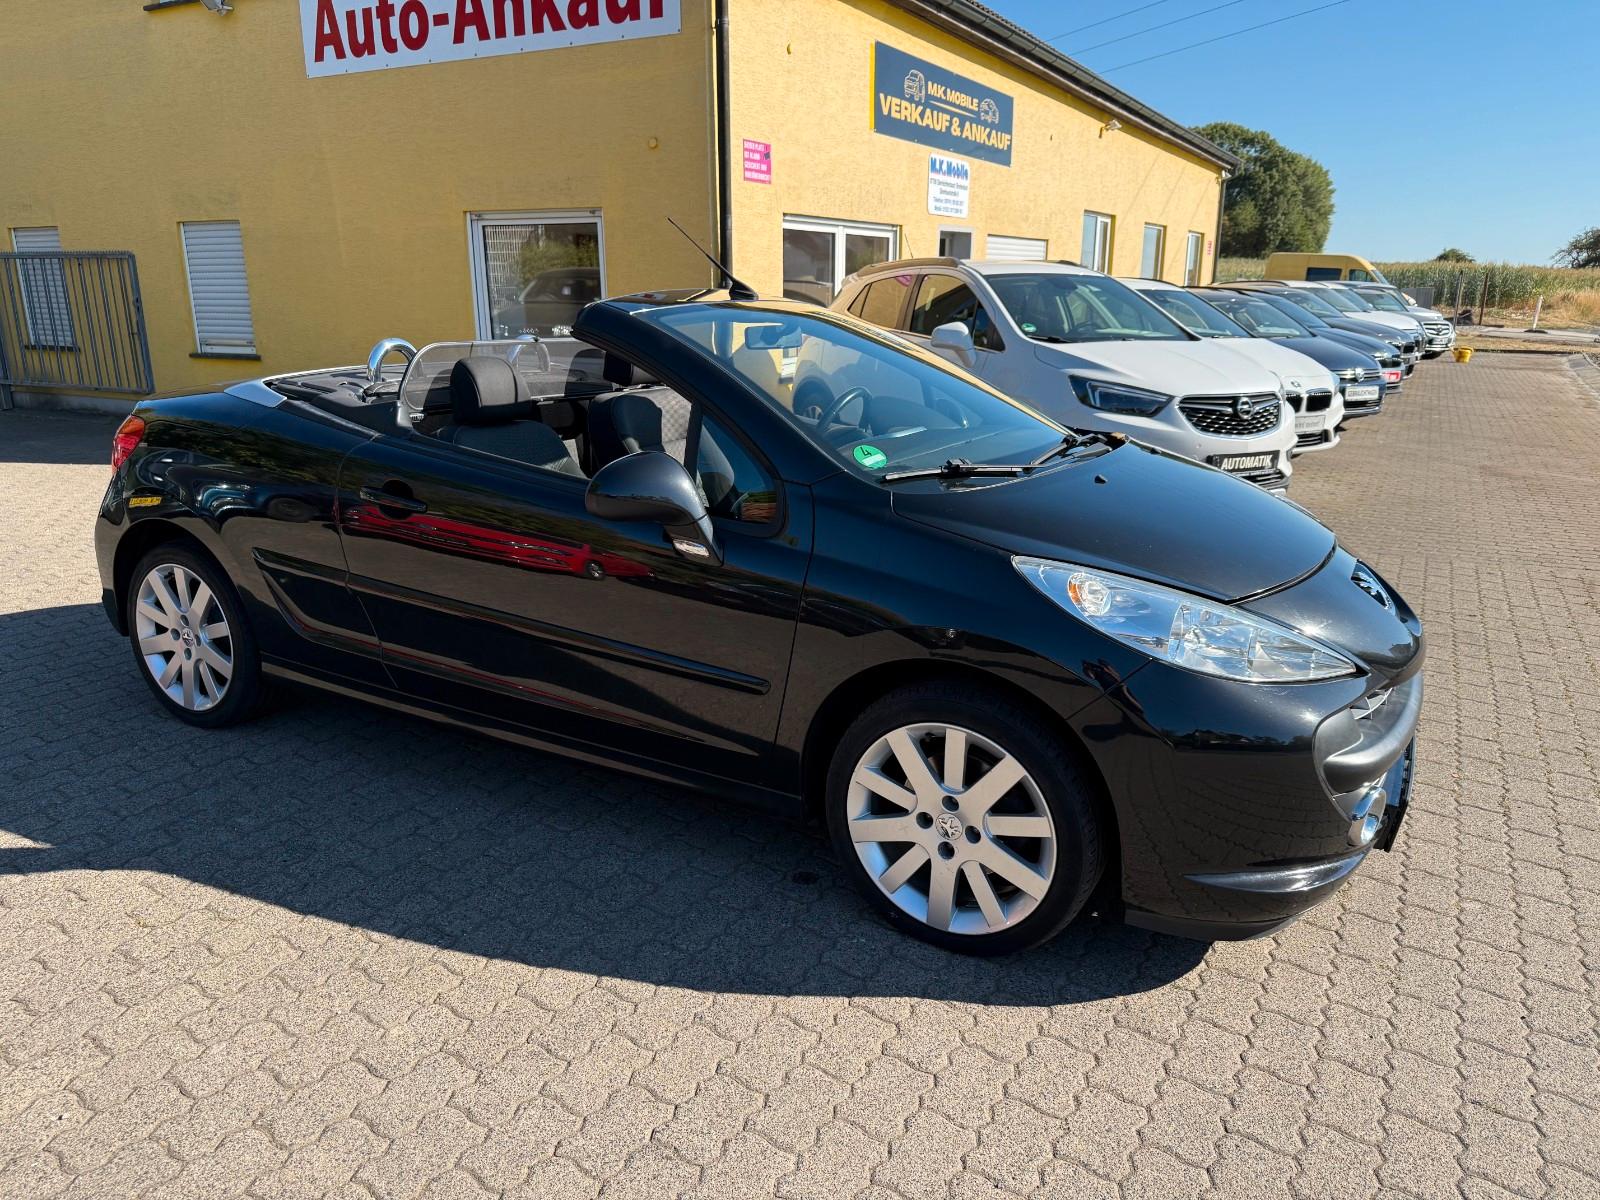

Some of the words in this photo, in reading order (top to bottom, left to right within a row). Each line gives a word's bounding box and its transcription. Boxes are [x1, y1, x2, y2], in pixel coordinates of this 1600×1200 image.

[314, 0, 664, 63] Auto-Anka
[879, 93, 950, 133] VERKAUF
[951, 117, 961, 137] &
[962, 121, 1011, 151] ANKAUF
[1221, 454, 1273, 470] AUTOMATIK
